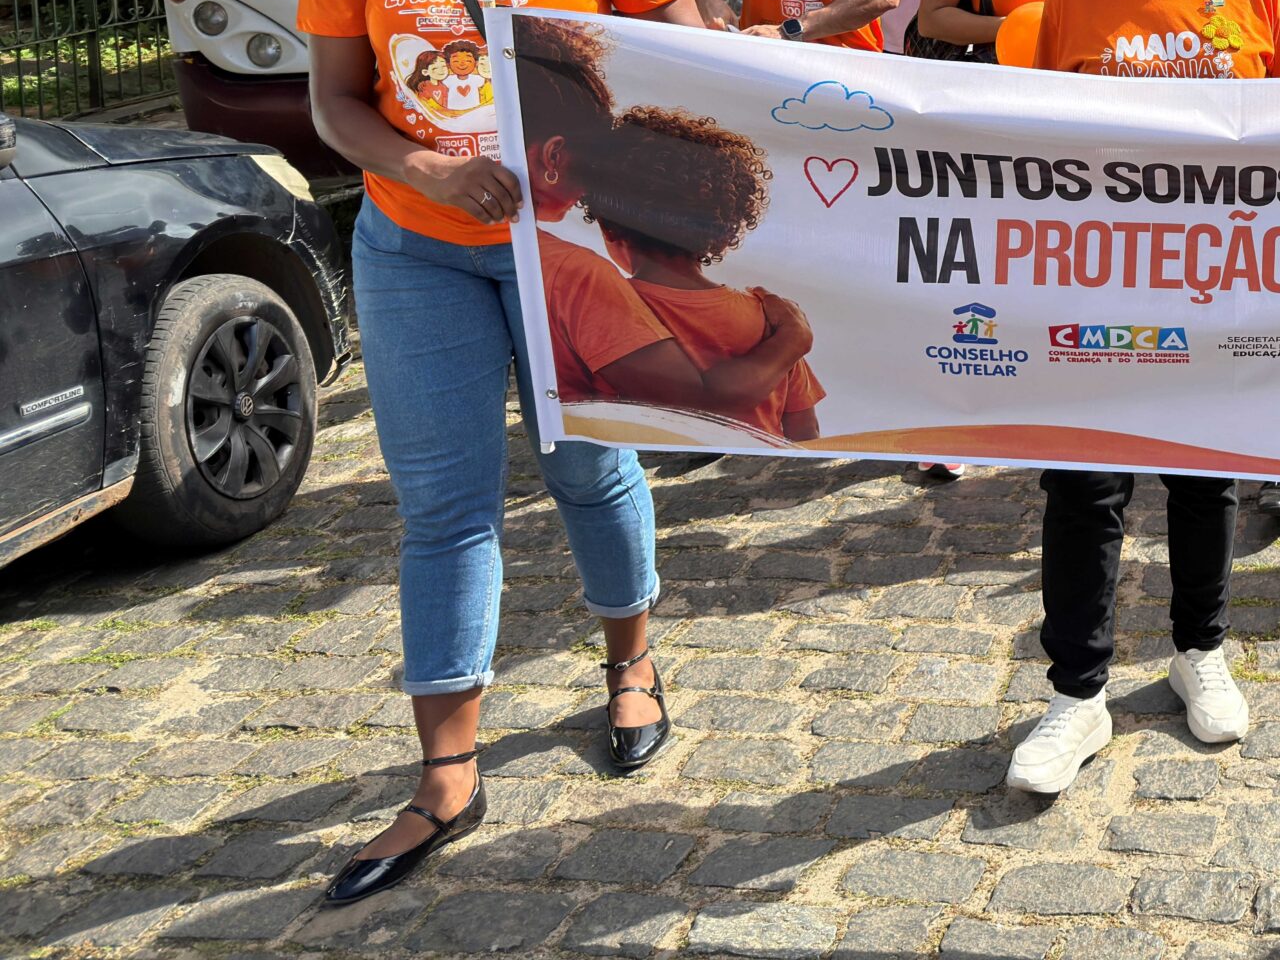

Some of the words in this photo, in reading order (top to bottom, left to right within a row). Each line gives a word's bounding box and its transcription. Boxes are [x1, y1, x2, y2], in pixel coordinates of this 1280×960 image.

[417, 16, 460, 27] proteger
[1115, 31, 1201, 62] MAIO
[438, 139, 470, 148] DISQUE
[867, 147, 1092, 202] JUNTOS
[896, 216, 981, 285] NA
[1054, 326, 1187, 349] CMDCA
[925, 345, 1029, 363] CONSELHO
[1048, 350, 1091, 358] CONSELHO
[938, 361, 1017, 377] TUTELAR
